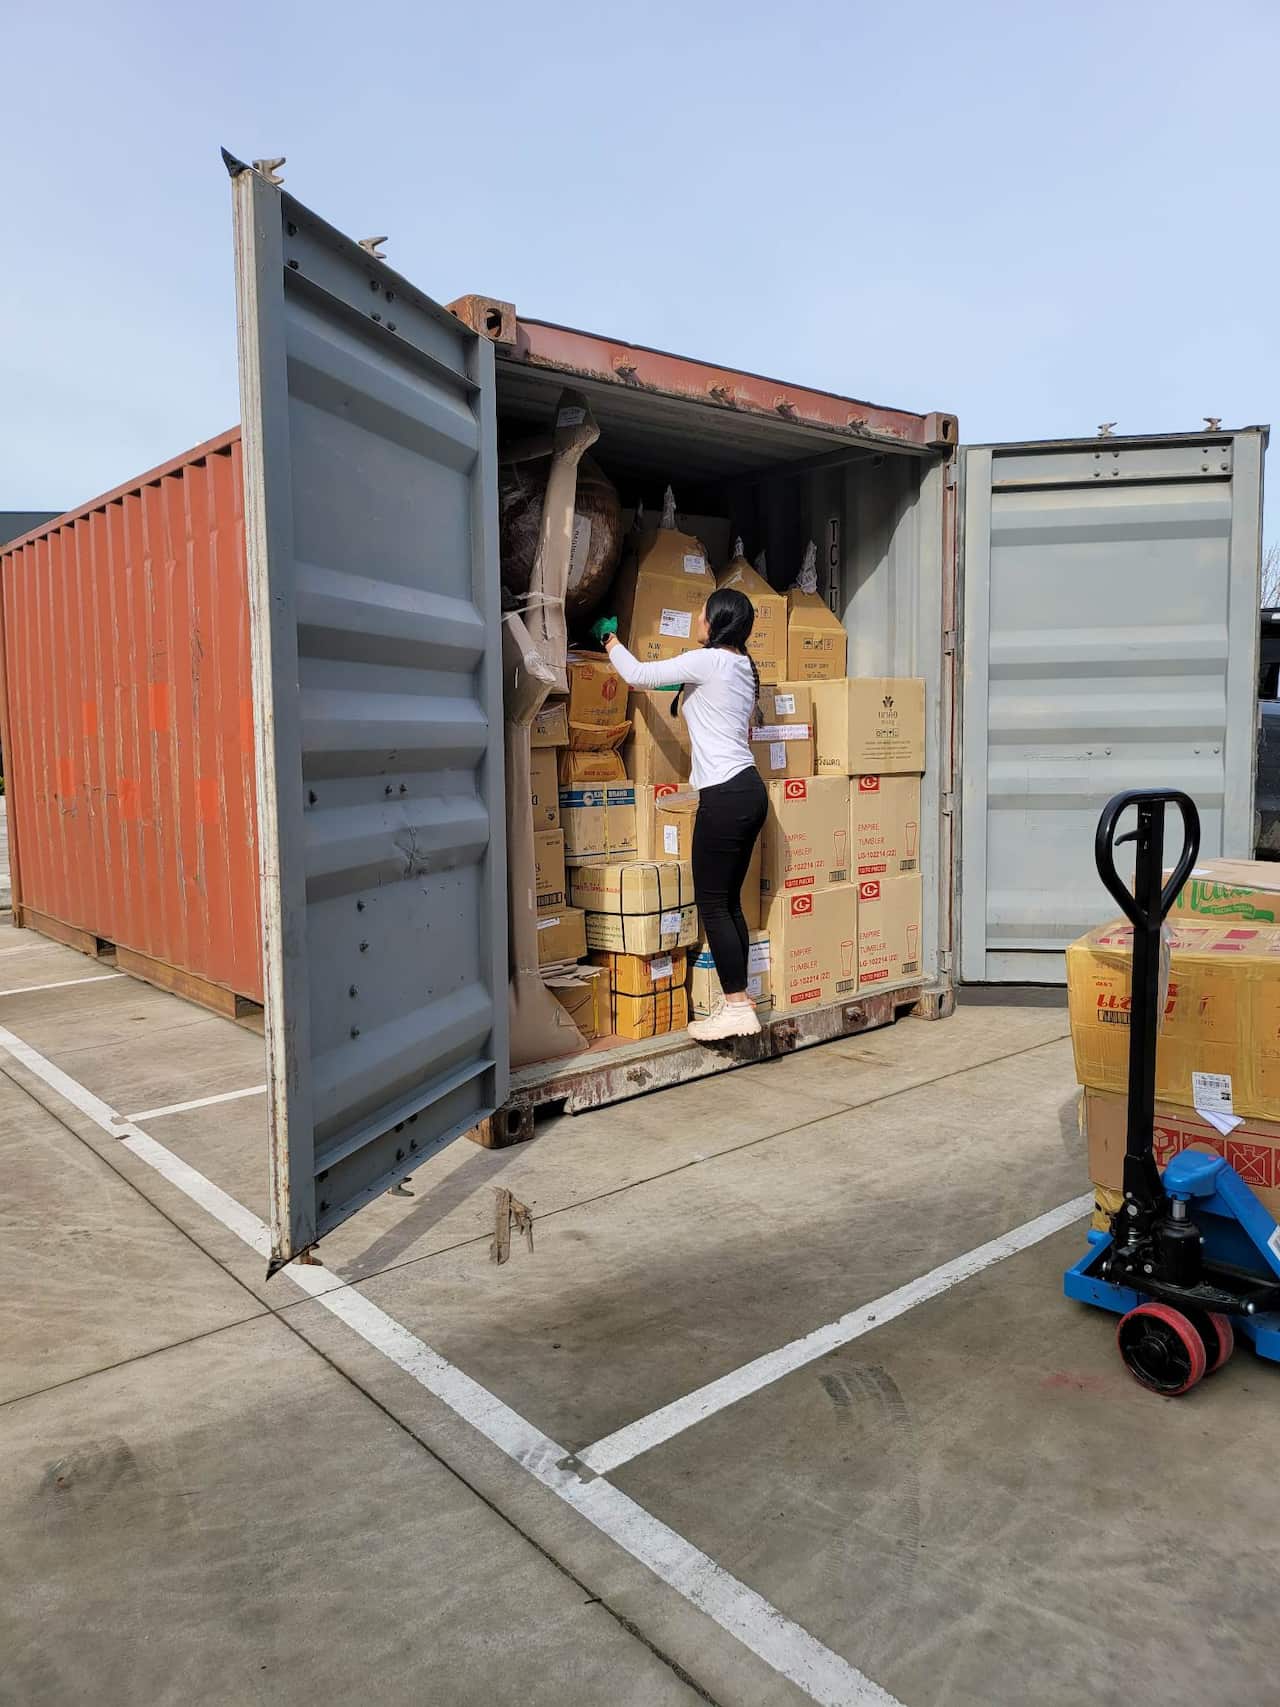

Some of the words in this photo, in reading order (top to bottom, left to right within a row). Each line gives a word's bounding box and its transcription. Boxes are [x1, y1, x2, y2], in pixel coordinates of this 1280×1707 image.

[830, 520, 838, 613] TCLU
[858, 823, 880, 832] EMPIRE
[784, 833, 807, 843] EMPIRE
[858, 837, 885, 846] TUMBLER
[784, 848, 812, 858] TUMBLER
[858, 850, 886, 860] LG-102214
[886, 848, 897, 857] (22)
[784, 861, 814, 873] LG-102214
[814, 860, 825, 869] (22)
[860, 930, 881, 940] EMPIRE
[790, 947, 812, 958] EMPIRE
[860, 943, 887, 954] TUMBLER
[791, 960, 818, 972] TUMBLER
[860, 956, 888, 968] LG-102214
[888, 954, 898, 963] (22)
[790, 974, 820, 988] LG-102214
[820, 972, 831, 982] (22)
